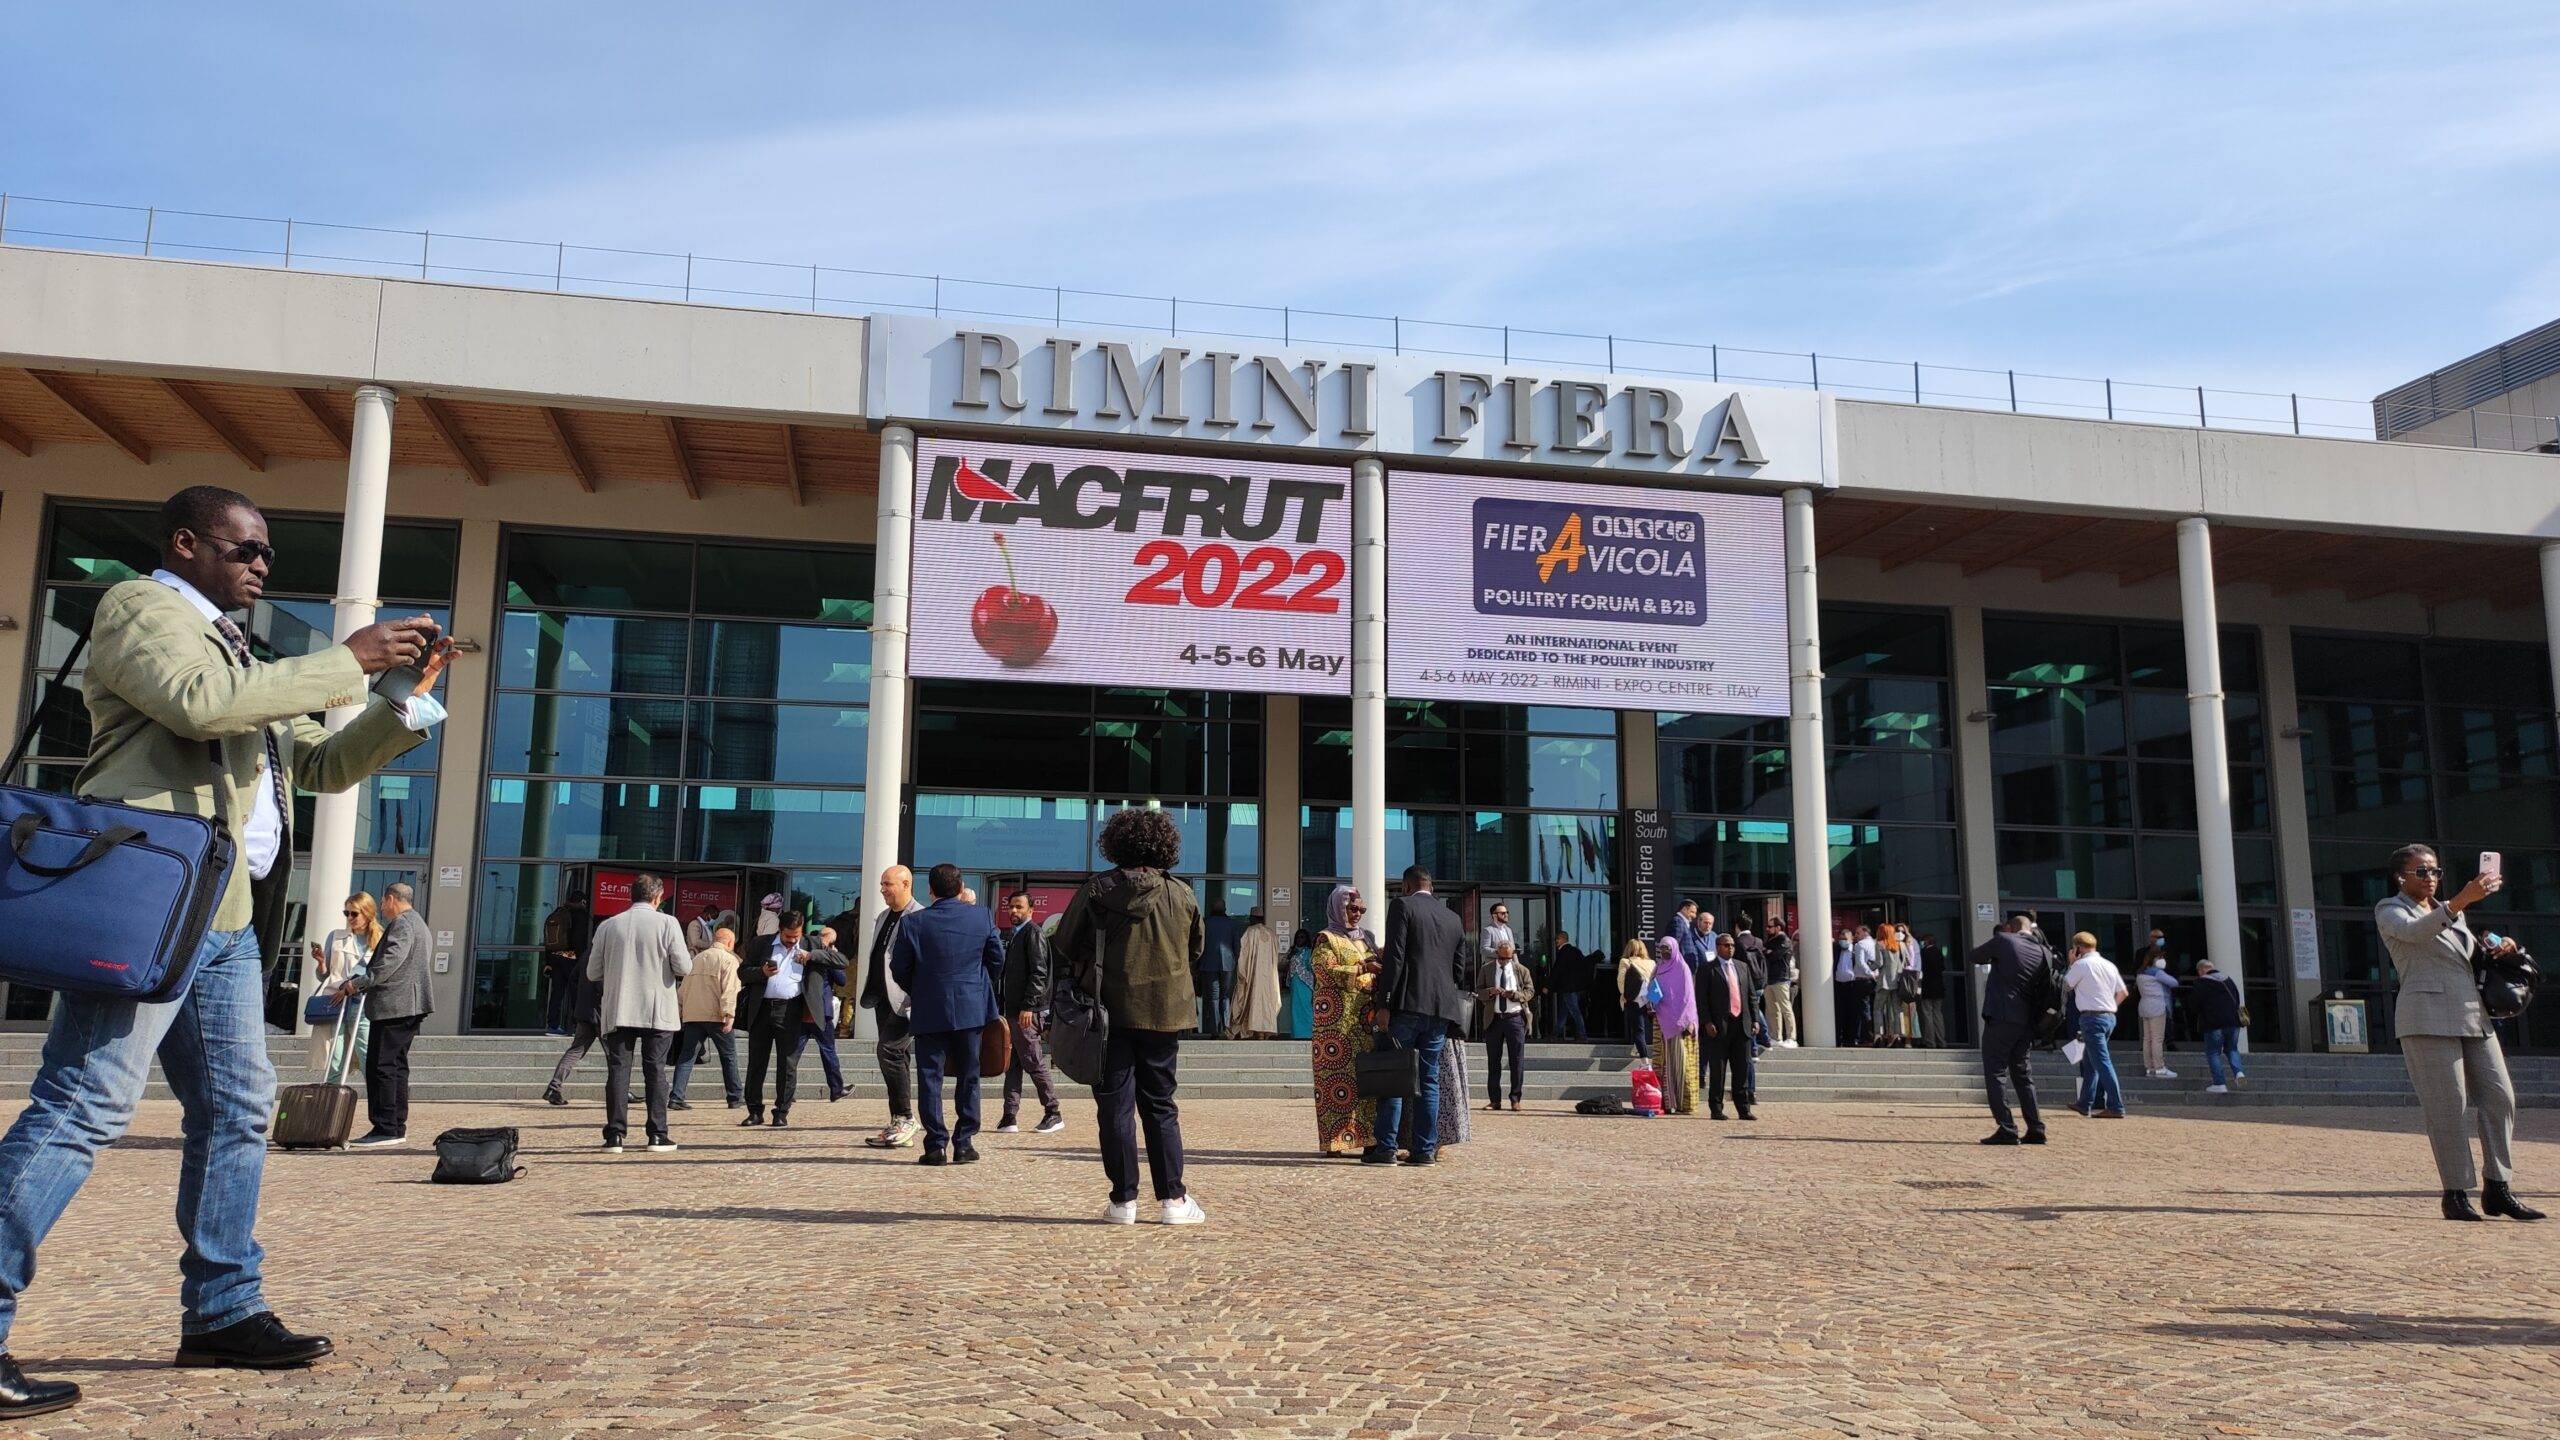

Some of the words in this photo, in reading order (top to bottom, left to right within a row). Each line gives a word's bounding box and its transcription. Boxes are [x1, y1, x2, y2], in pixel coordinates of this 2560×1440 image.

[953, 331, 1376, 437] RIMINI
[1434, 370, 1769, 464] FIERA
[922, 456, 1345, 543] MACFRUT
[1124, 540, 1345, 614] 2022
[1483, 588, 1568, 609] POULTRY
[1571, 593, 1640, 613] FORUM
[1643, 598, 1657, 614] &
[1660, 599, 1696, 616] B2B
[1505, 634, 1526, 646] AN
[1530, 636, 1634, 651] INTERNATIONAL
[1639, 641, 1679, 654] EVENT
[1180, 644, 1266, 668] 4-5-6
[1278, 648, 1345, 676] May
[1467, 648, 1537, 662] DEDICATED
[1541, 651, 1559, 663] TO
[1563, 653, 1586, 665] THE
[1591, 655, 1647, 669] POULTRY
[1652, 658, 1715, 672] INDUSTRY
[1419, 669, 1456, 683] 4-5-6
[1462, 671, 1495, 685] MAY
[1500, 673, 1538, 687] 2022
[1553, 675, 1600, 690] RIMINI
[1614, 678, 1652, 693] EXPO
[1657, 680, 1713, 696] CENTRE
[1727, 684, 1761, 698] ITALY
[1634, 809, 1658, 824] Sud
[1635, 825, 1667, 839] South
[1636, 845, 1654, 885] Fiera
[600, 881, 633, 893] Ser.m
[1637, 888, 1655, 941] Rimini
